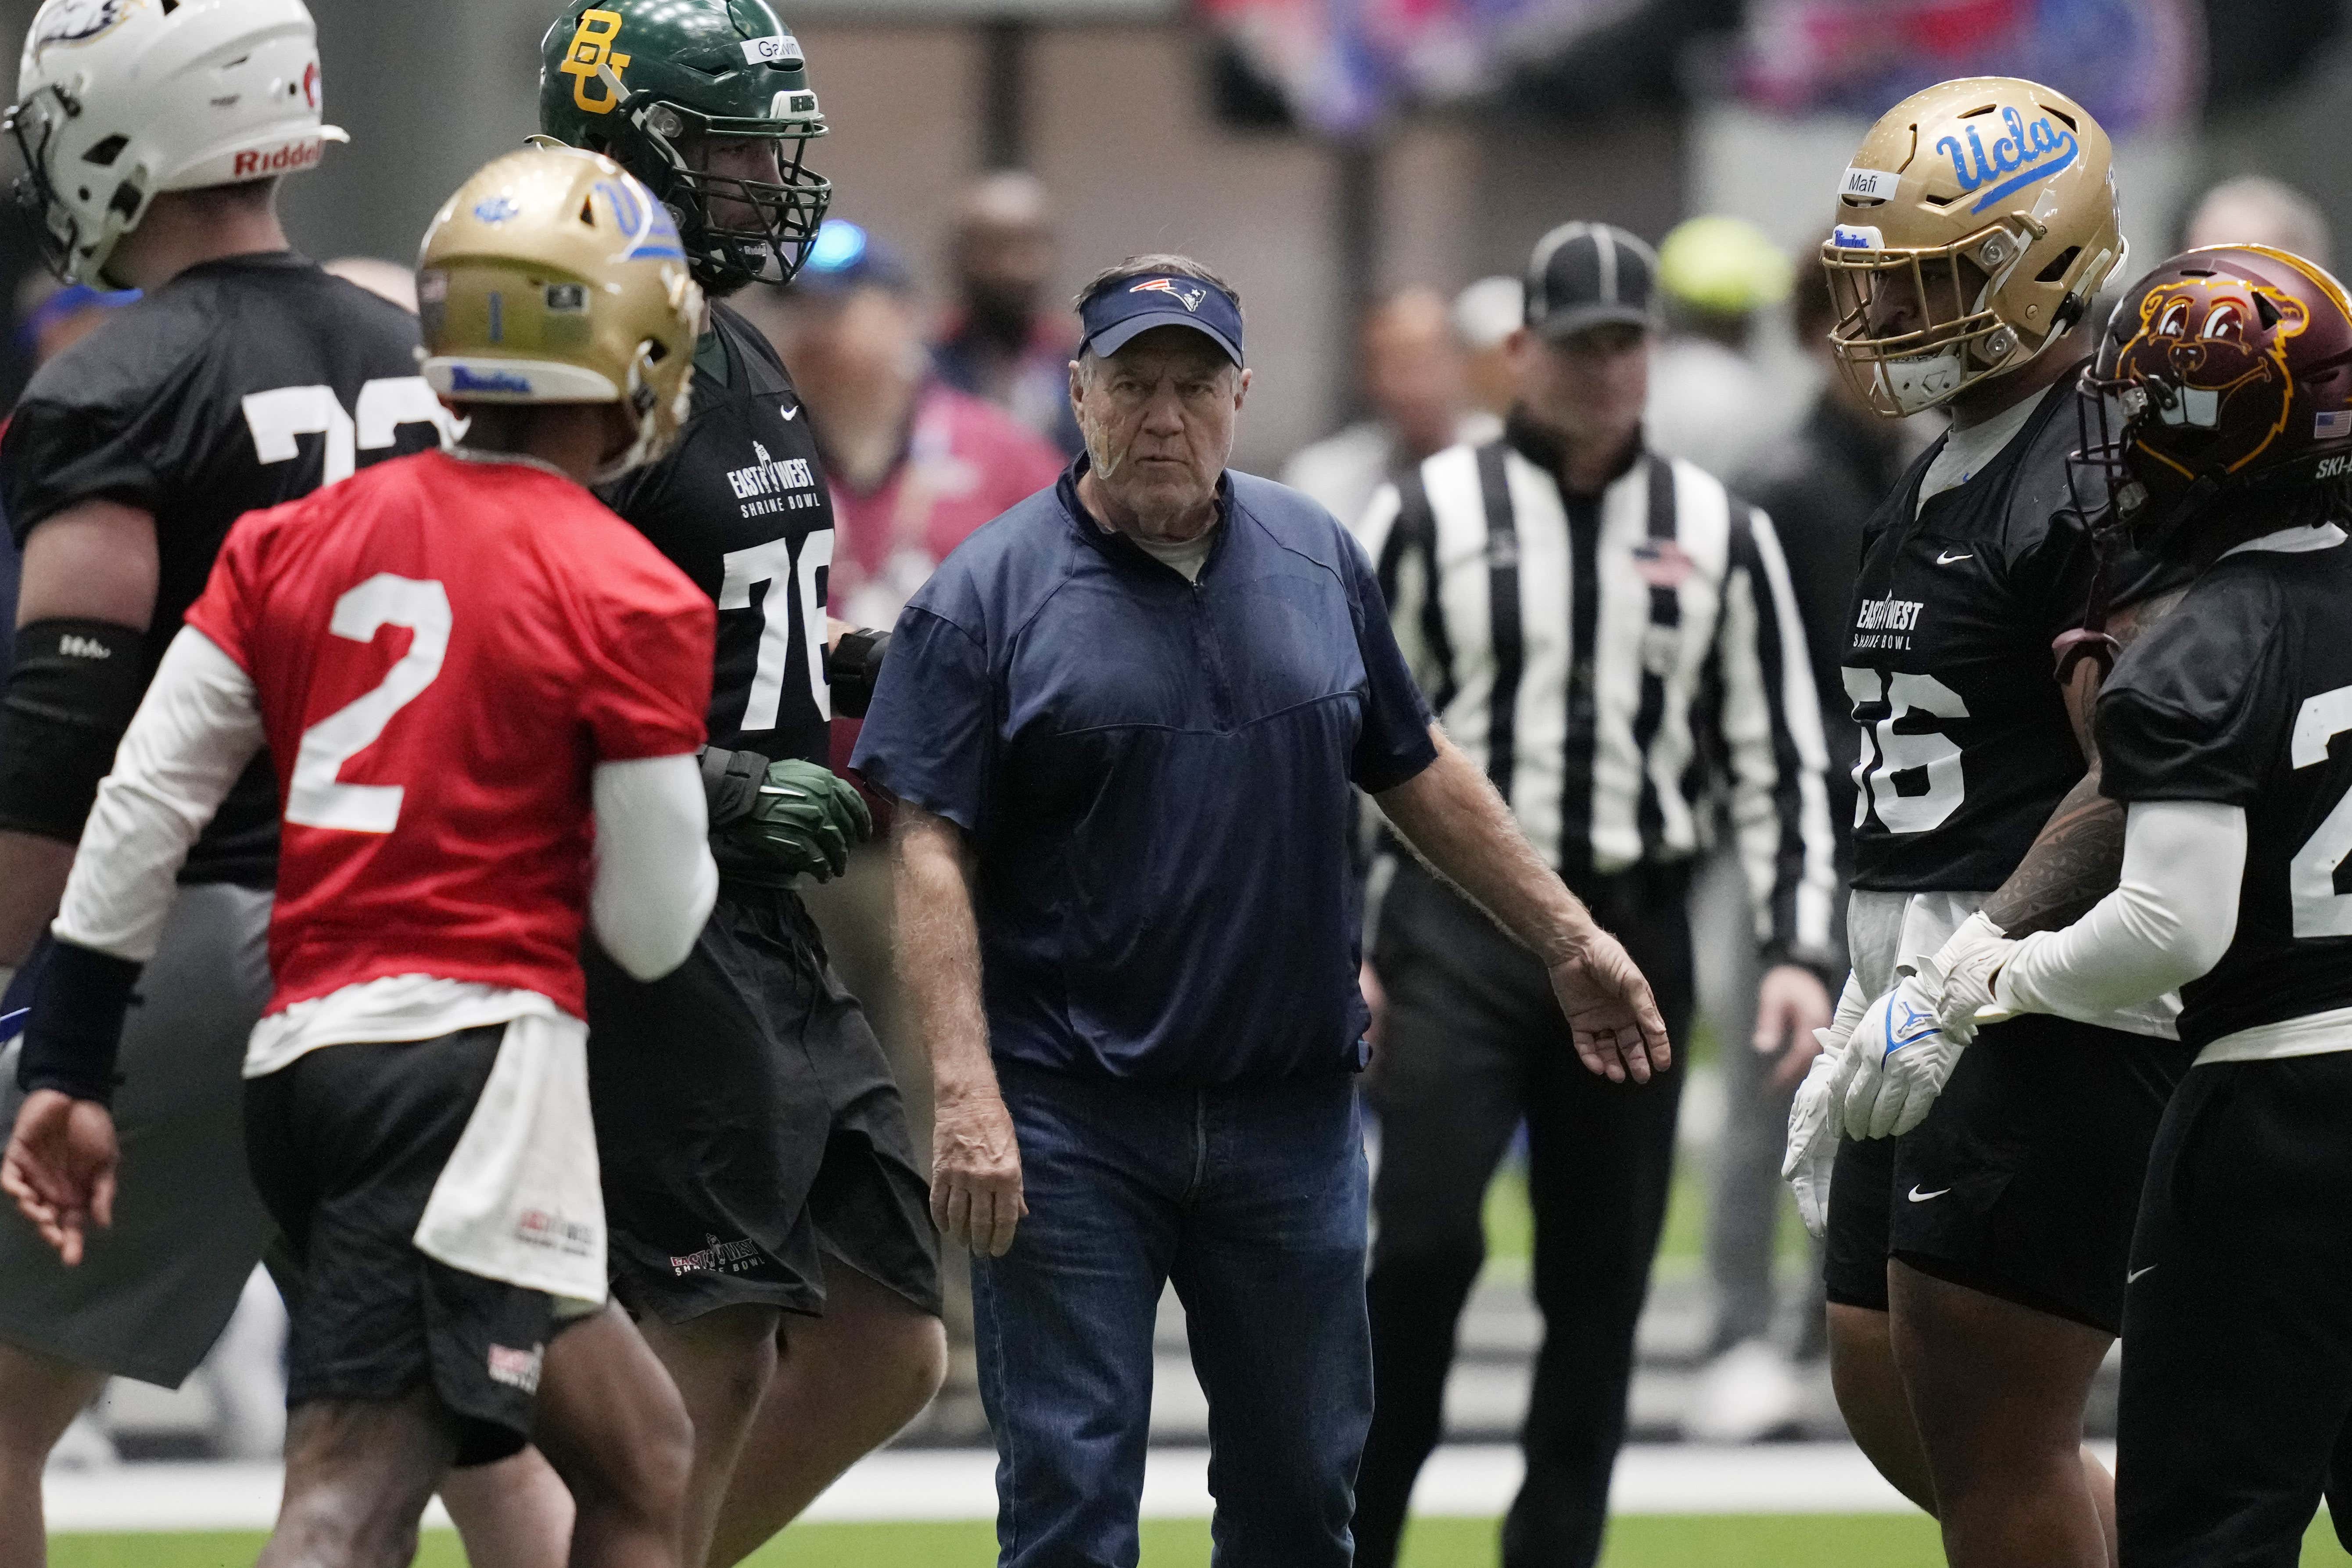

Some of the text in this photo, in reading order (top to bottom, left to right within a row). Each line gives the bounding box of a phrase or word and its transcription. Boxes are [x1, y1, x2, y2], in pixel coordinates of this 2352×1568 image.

[1849, 174, 1878, 192] Mafi
[740, 493, 821, 518] SHRINE BOWL
[1853, 633, 1911, 650] SHRINE BOWL
[285, 573, 452, 833] 2
[733, 1257, 765, 1272] BOWL
